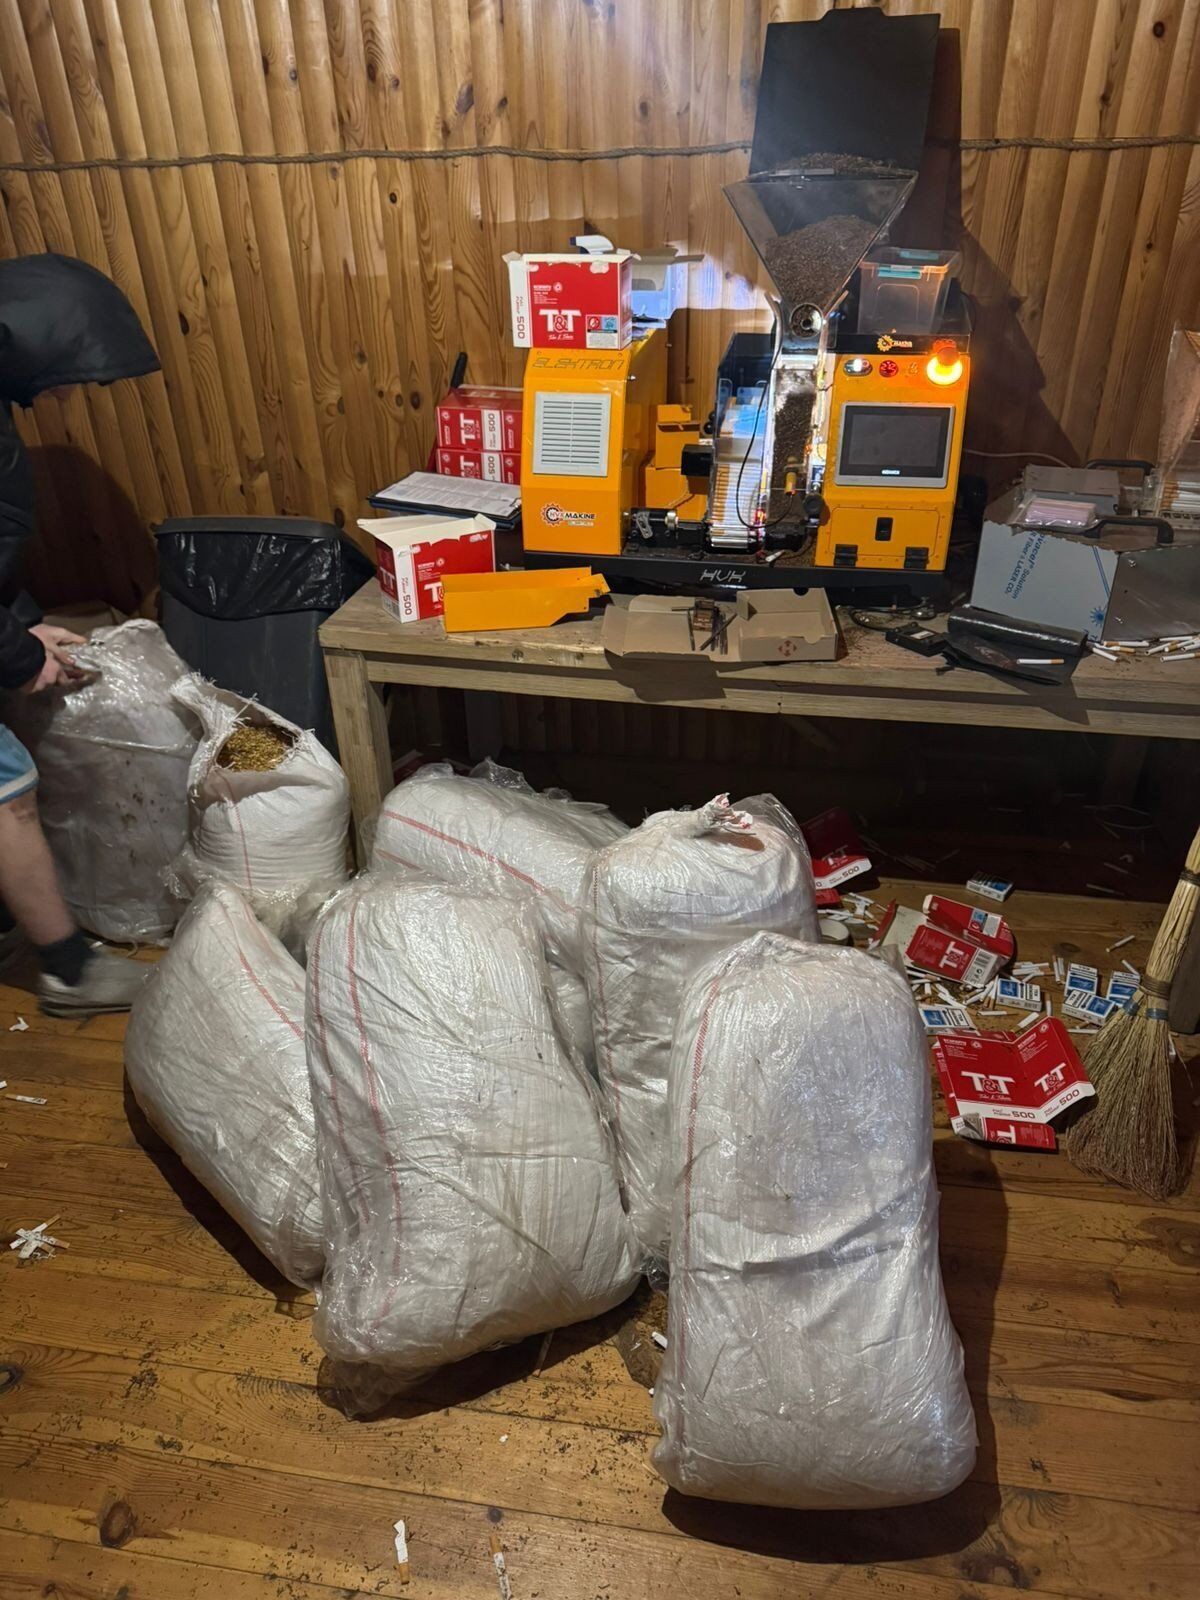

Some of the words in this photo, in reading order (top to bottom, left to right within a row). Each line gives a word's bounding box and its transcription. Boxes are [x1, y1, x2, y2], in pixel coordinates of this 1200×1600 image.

[516, 315, 526, 340] 500
[539, 308, 582, 333] T&T
[459, 412, 477, 445] T&T
[487, 412, 496, 432] 500
[487, 455, 496, 475] 500
[564, 511, 596, 520] MAKINE
[1011, 568, 1031, 600] Solution
[403, 594, 413, 616] 500
[841, 865, 860, 878] 500
[938, 940, 965, 969] T&T
[960, 1070, 1015, 1096] T&T
[1033, 1062, 1067, 1093] T&T
[1011, 1110, 1036, 1120] 500
[1058, 1088, 1081, 1106] 500
